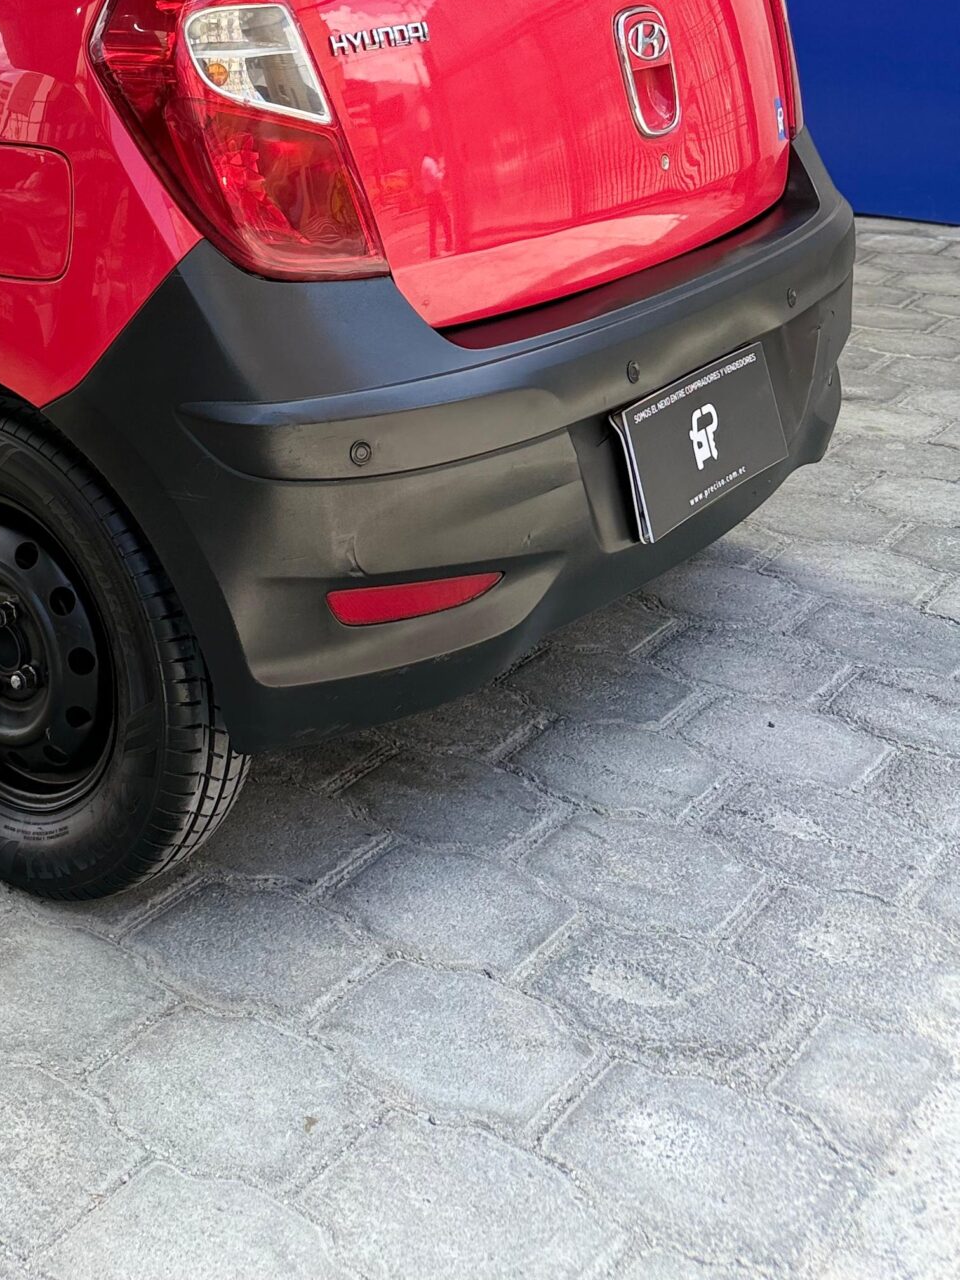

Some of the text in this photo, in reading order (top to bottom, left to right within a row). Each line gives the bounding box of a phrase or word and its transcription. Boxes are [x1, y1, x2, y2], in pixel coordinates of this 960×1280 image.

[328, 22, 430, 56] HYUNDAI
[633, 407, 651, 424] SOMOS
[651, 404, 658, 414] EL
[657, 397, 671, 410] NEXO
[670, 388, 686, 404] ENTRE
[685, 370, 721, 395] COMPRADORES
[723, 353, 757, 376] VENDEDORES
[689, 466, 746, 506] www.preciso.com.ec
